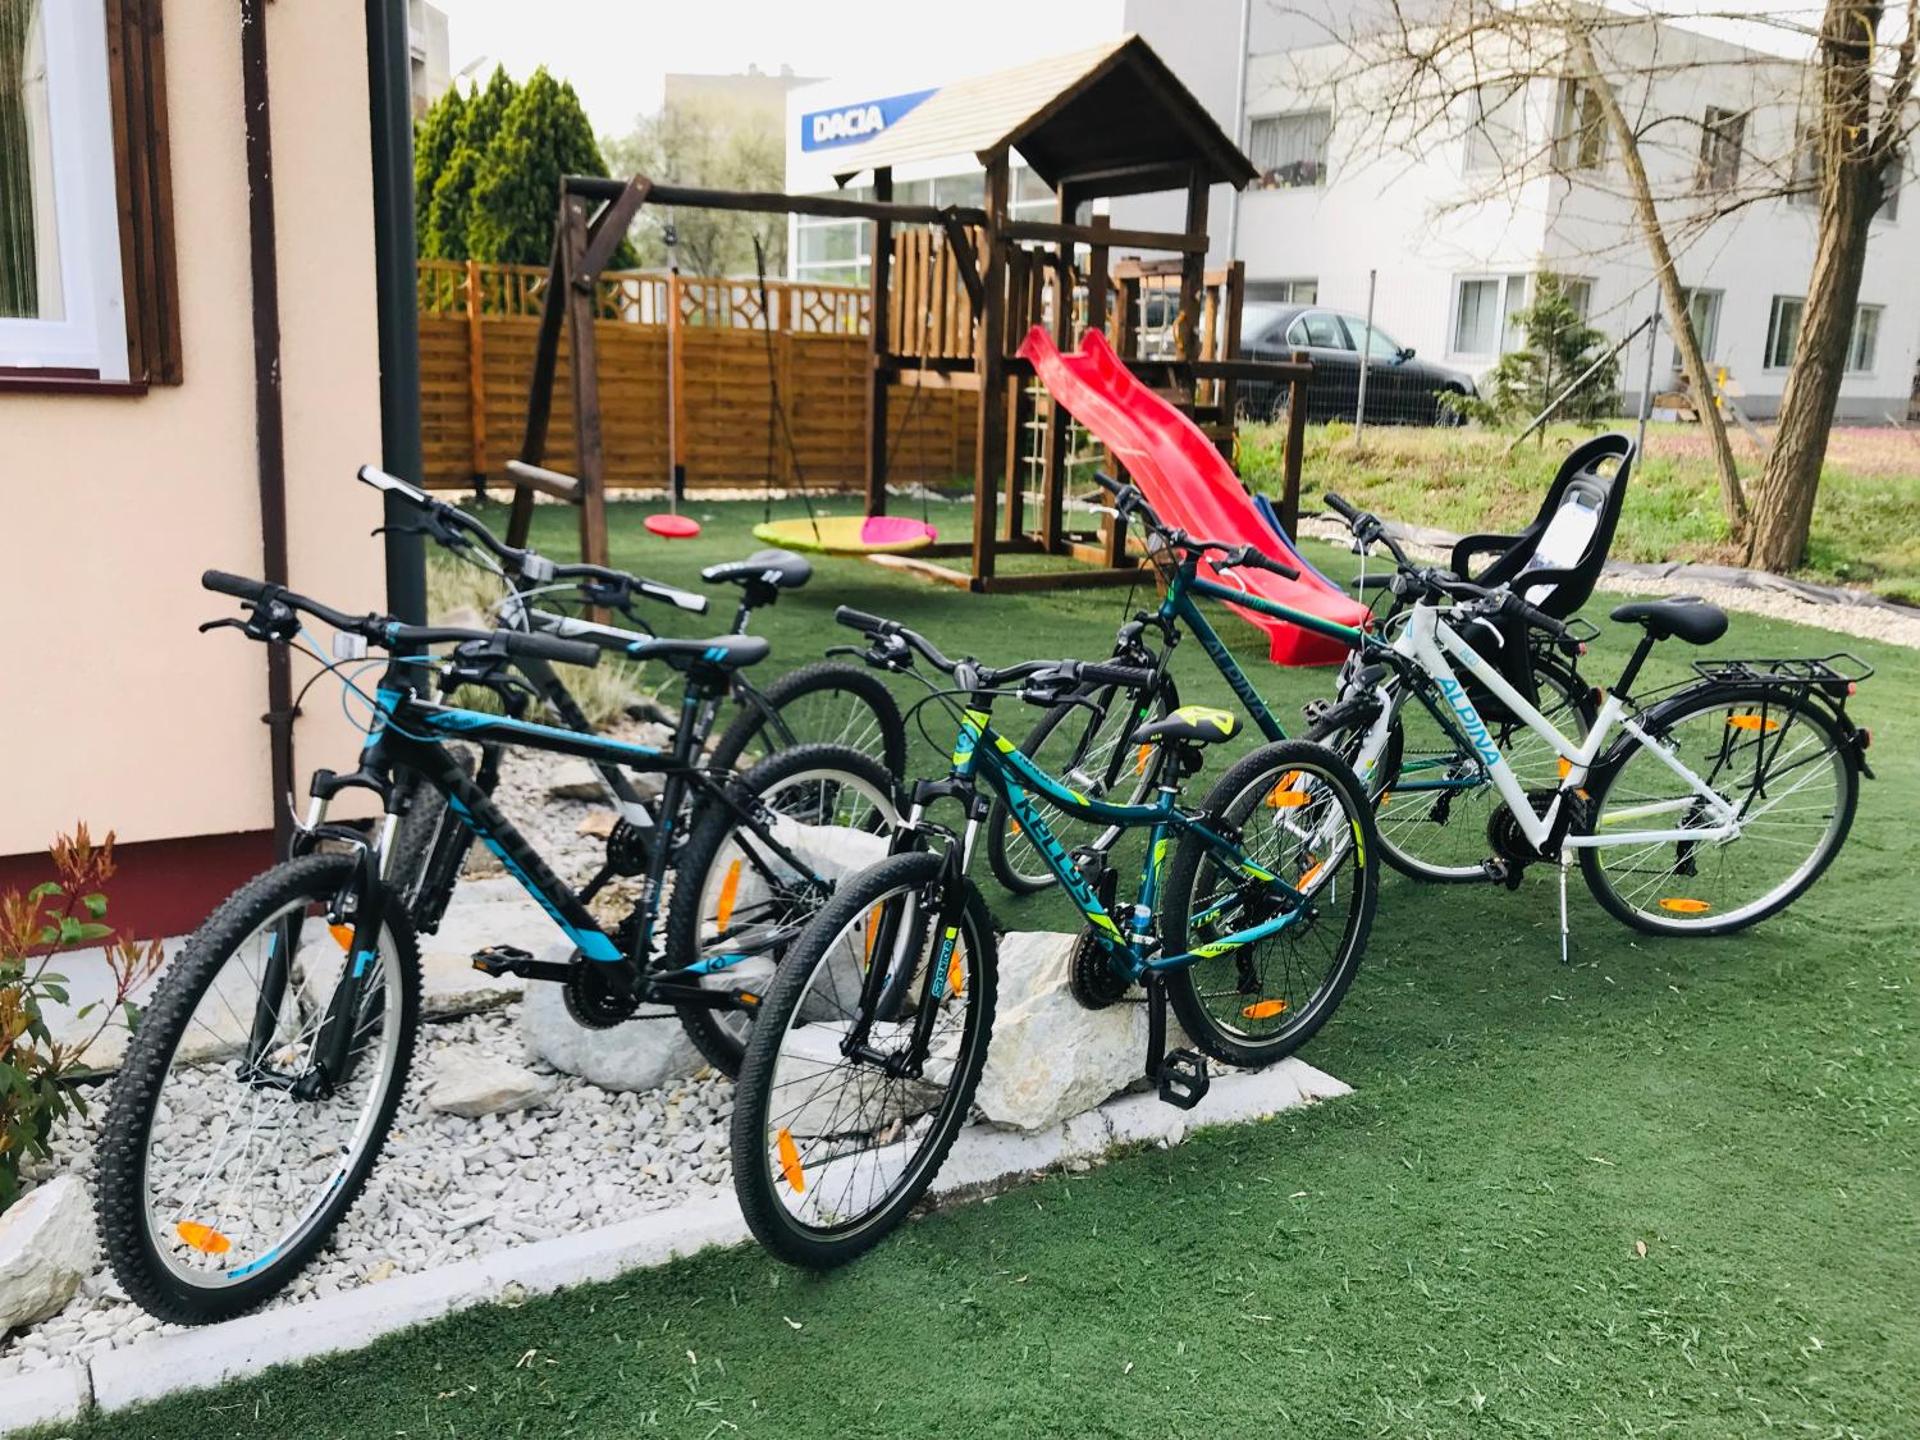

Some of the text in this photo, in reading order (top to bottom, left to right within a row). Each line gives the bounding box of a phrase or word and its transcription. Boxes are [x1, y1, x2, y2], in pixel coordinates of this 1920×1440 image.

[813, 105, 885, 142] DACIA
[1205, 641, 1266, 719] ALPINA
[1435, 676, 1500, 766] ALPINA
[1016, 798, 1091, 904] KELLYS
